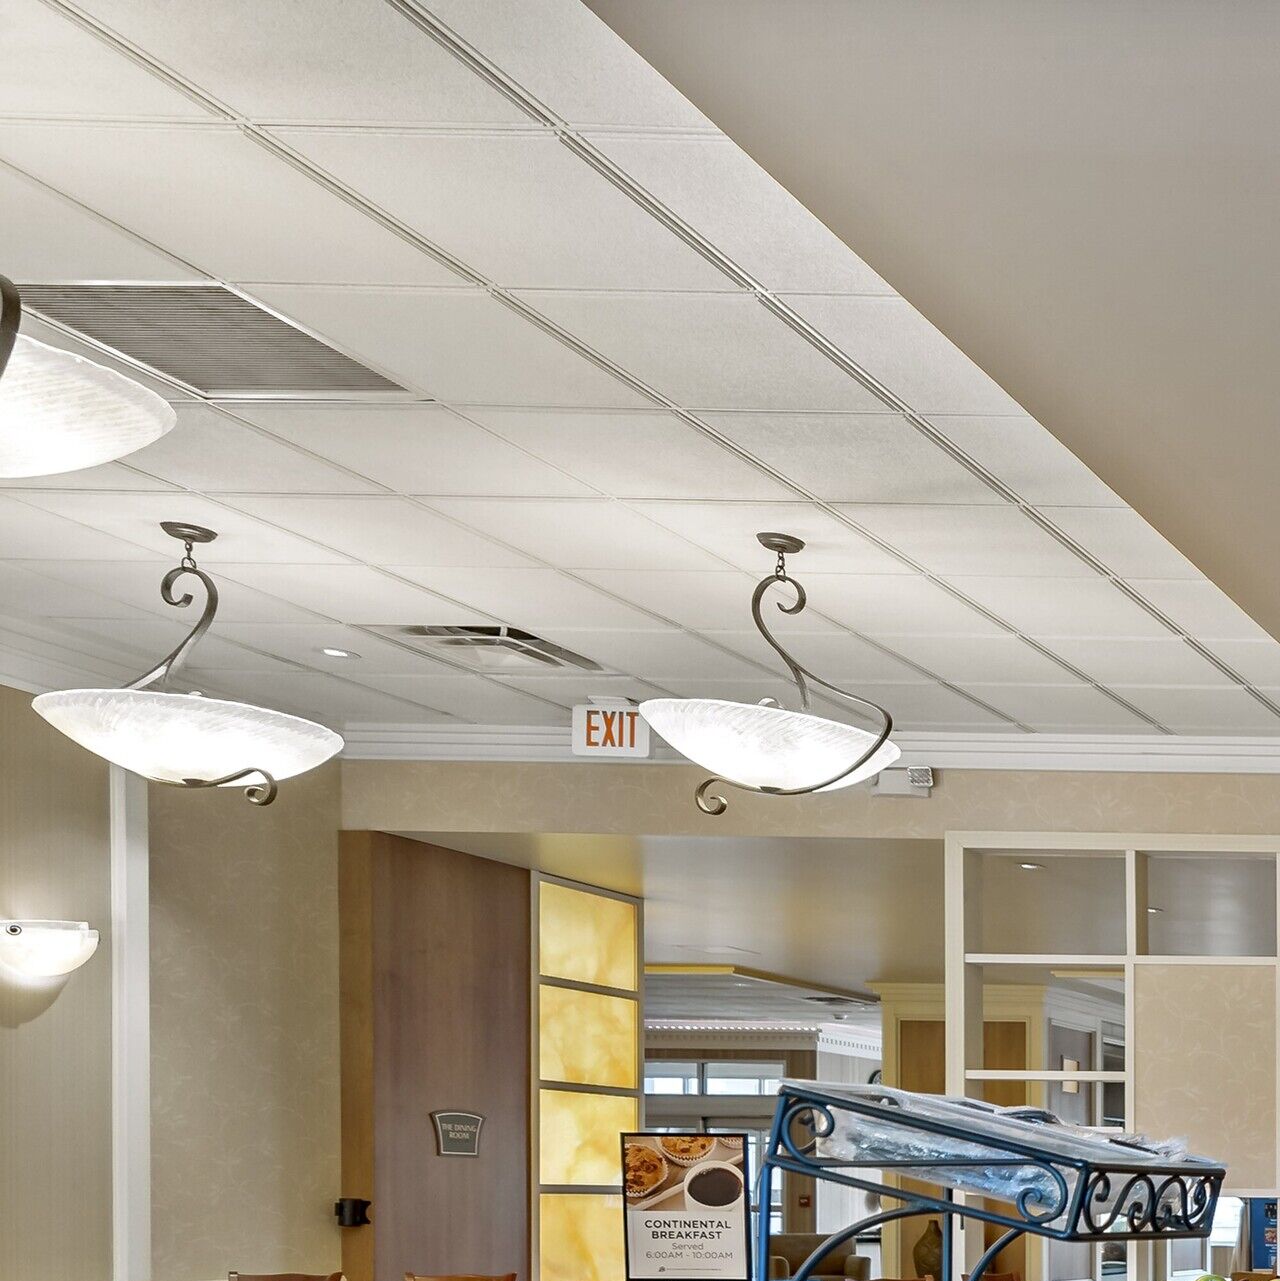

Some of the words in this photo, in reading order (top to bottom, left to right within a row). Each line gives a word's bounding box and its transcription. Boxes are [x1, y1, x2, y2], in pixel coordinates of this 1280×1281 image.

[586, 710, 640, 748] EXIT
[454, 1124, 477, 1132] DINING
[448, 1131, 470, 1139] ROOM
[644, 1219, 732, 1229] CONTINENTAL
[651, 1230, 723, 1240] BREAKFAST
[672, 1242, 704, 1250] Served
[645, 1251, 683, 1259] 6:00AM
[692, 1251, 733, 1259] 10:00AM
